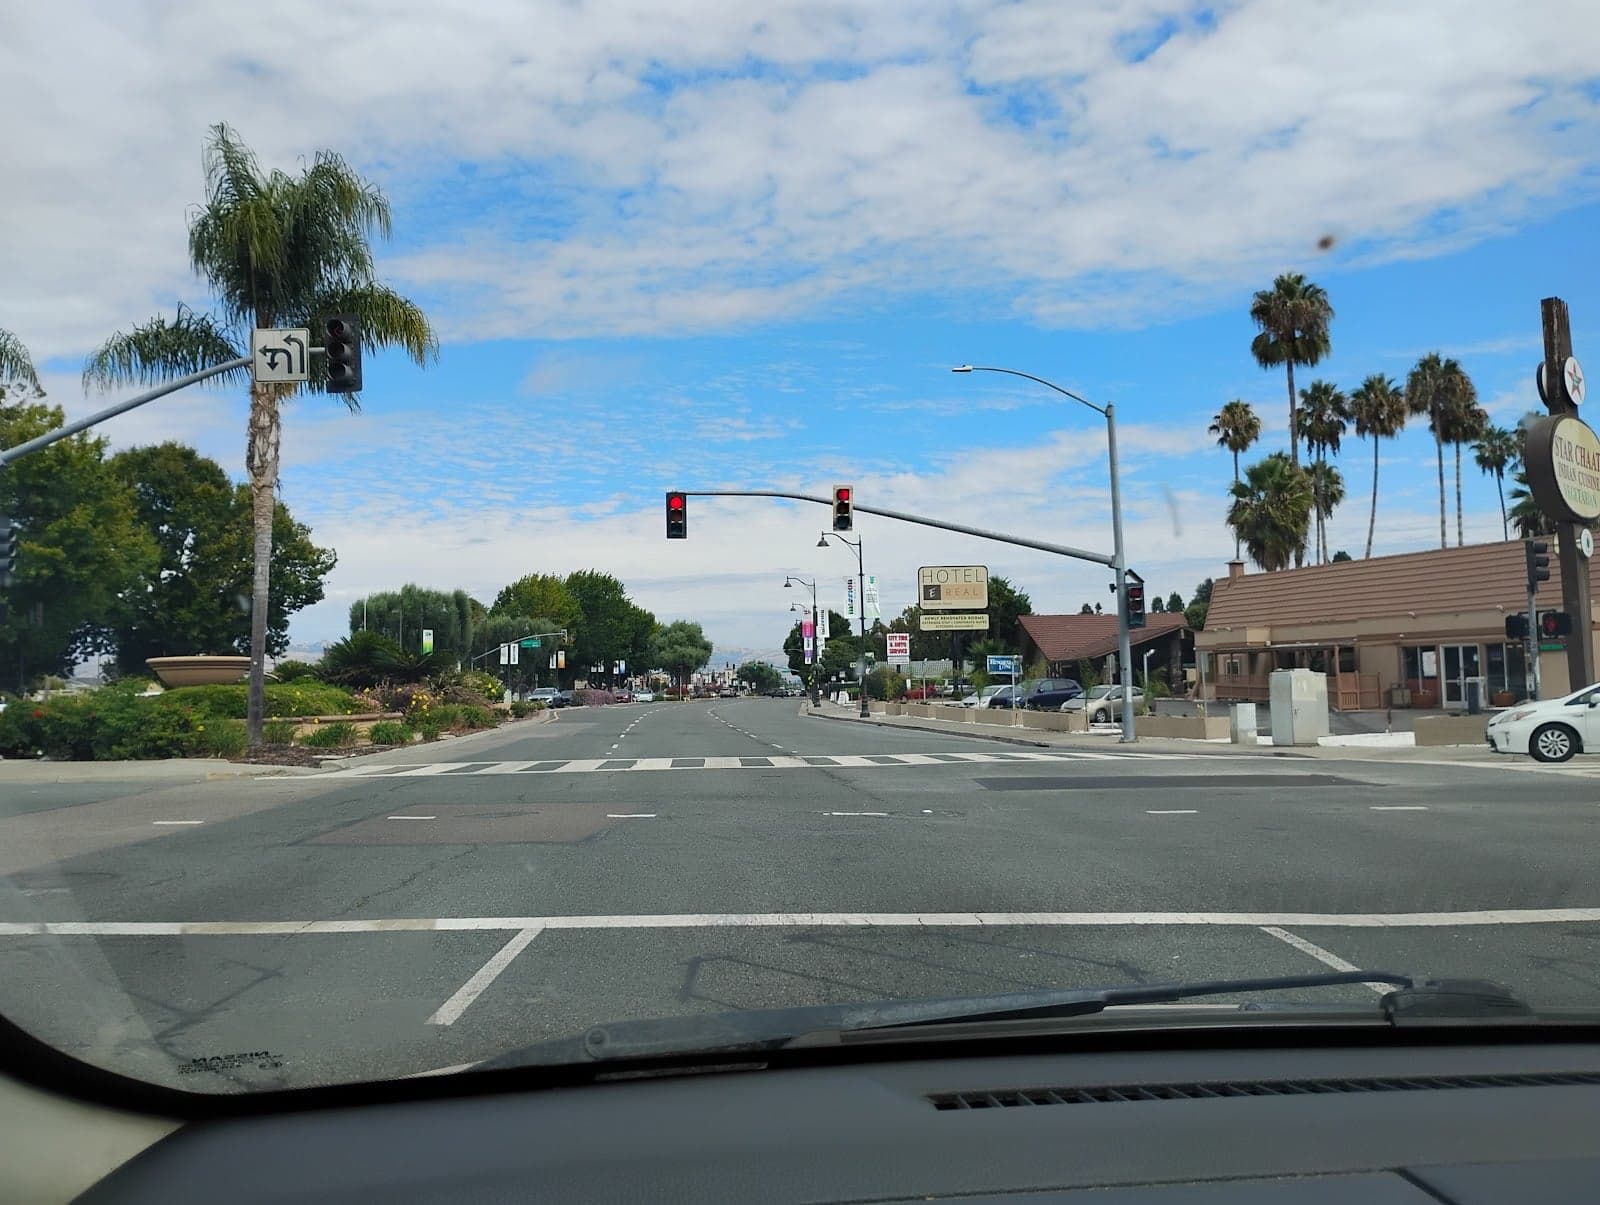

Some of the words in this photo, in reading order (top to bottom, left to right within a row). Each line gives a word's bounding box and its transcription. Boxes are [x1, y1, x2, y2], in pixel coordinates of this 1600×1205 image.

[1554, 435, 1574, 462] STAR
[1574, 445, 1600, 472] CHAAT
[1558, 462, 1576, 481] INDIAN
[1578, 471, 1600, 491] CUISINE
[922, 568, 985, 584] HOTEL
[945, 587, 979, 597] REAL
